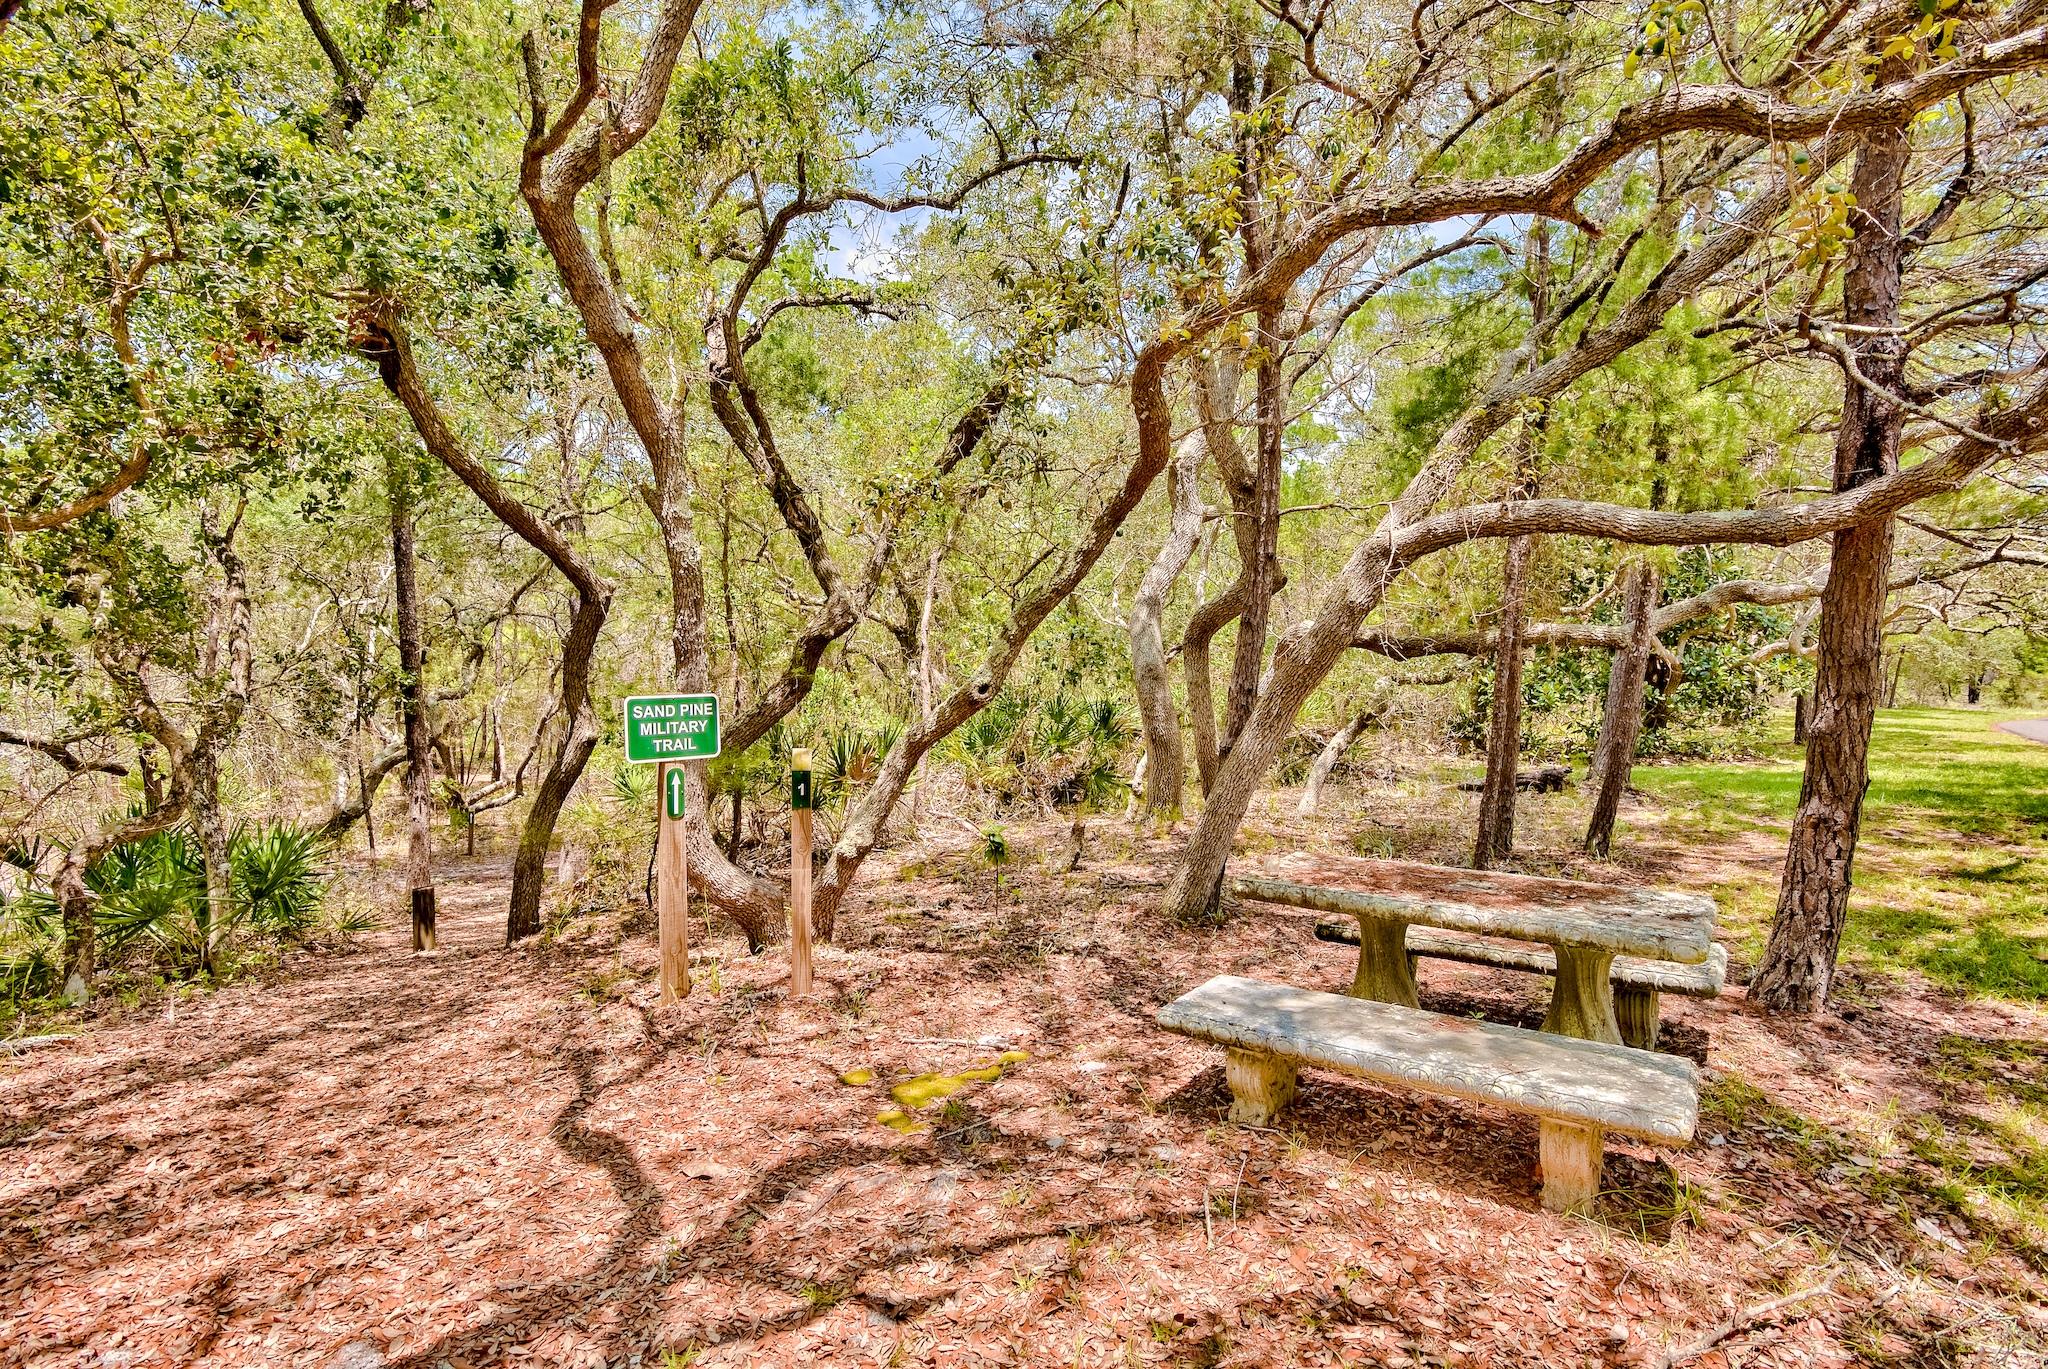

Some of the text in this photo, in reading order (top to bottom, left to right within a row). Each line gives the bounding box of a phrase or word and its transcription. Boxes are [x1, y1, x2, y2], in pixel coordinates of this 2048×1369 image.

[633, 703, 713, 719] SAND PINE
[640, 720, 708, 736] MILITARY
[653, 738, 696, 752] TRAIL
[797, 783, 805, 796] 1
